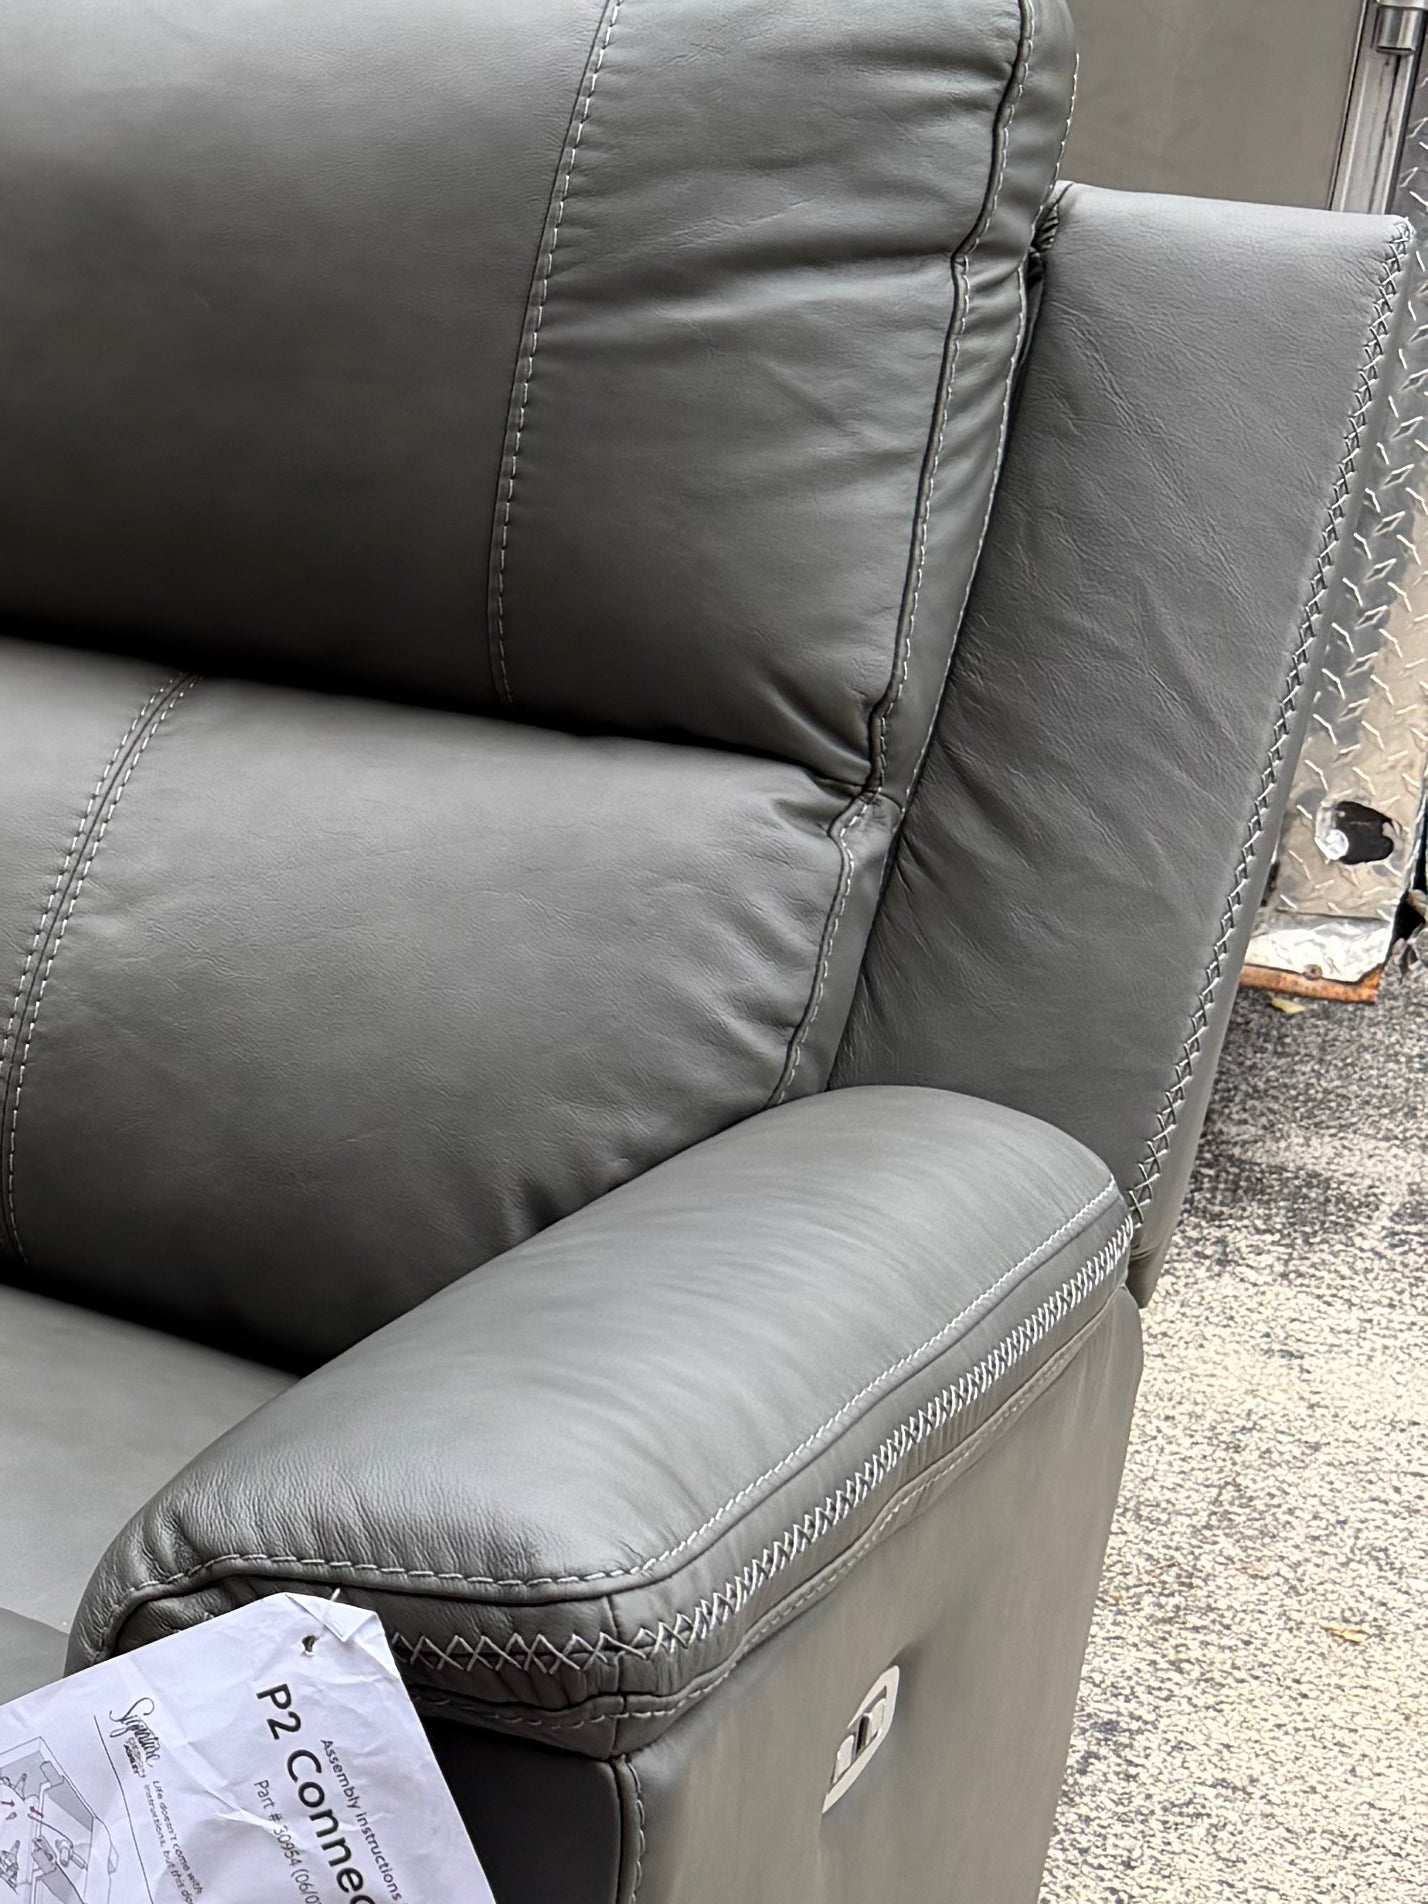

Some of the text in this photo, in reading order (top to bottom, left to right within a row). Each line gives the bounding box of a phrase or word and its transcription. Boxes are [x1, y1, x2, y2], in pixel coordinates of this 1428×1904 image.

[256, 1683, 302, 1740] P2
[253, 1779, 276, 1811] Part
[272, 1823, 303, 1869] 30954
[320, 1738, 361, 1810] Assembly
[355, 1810, 403, 1902] instructions
[174, 1842, 191, 1873] come
[187, 1870, 204, 1895] with
